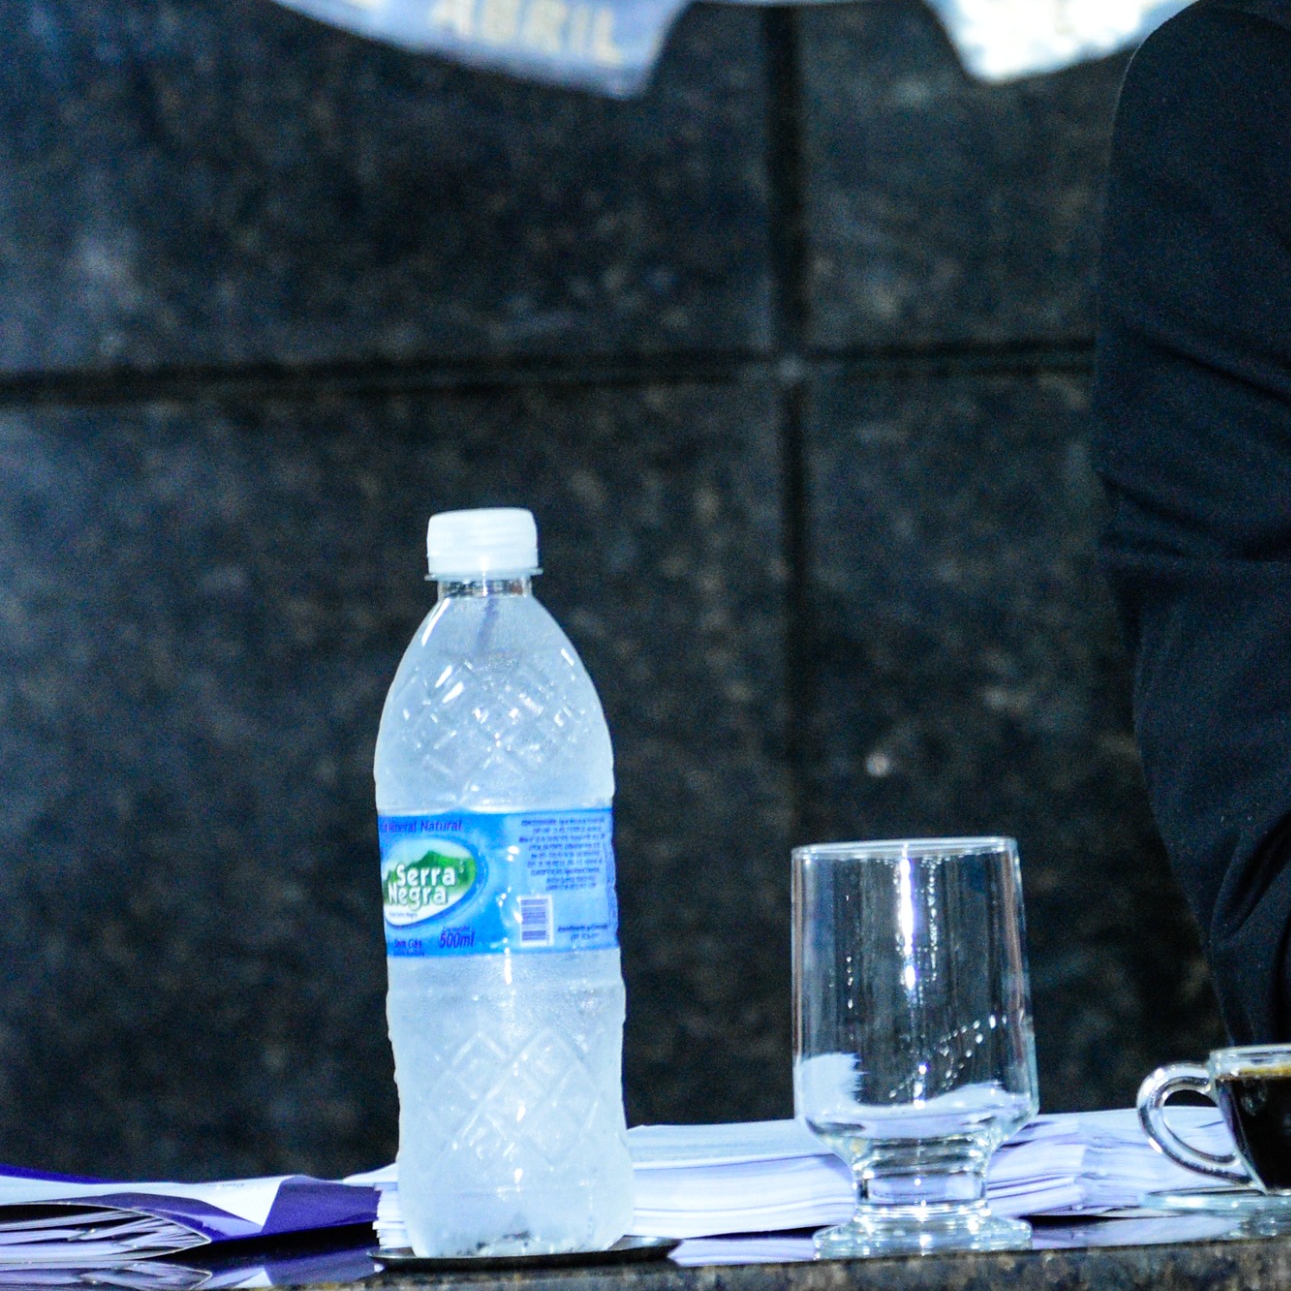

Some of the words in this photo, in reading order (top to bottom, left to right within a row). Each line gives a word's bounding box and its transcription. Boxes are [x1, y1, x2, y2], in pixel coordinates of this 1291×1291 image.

[421, 819, 463, 832] Natural
[396, 863, 456, 887] Serra
[388, 883, 448, 911] Negra
[439, 930, 475, 949] 500ml
